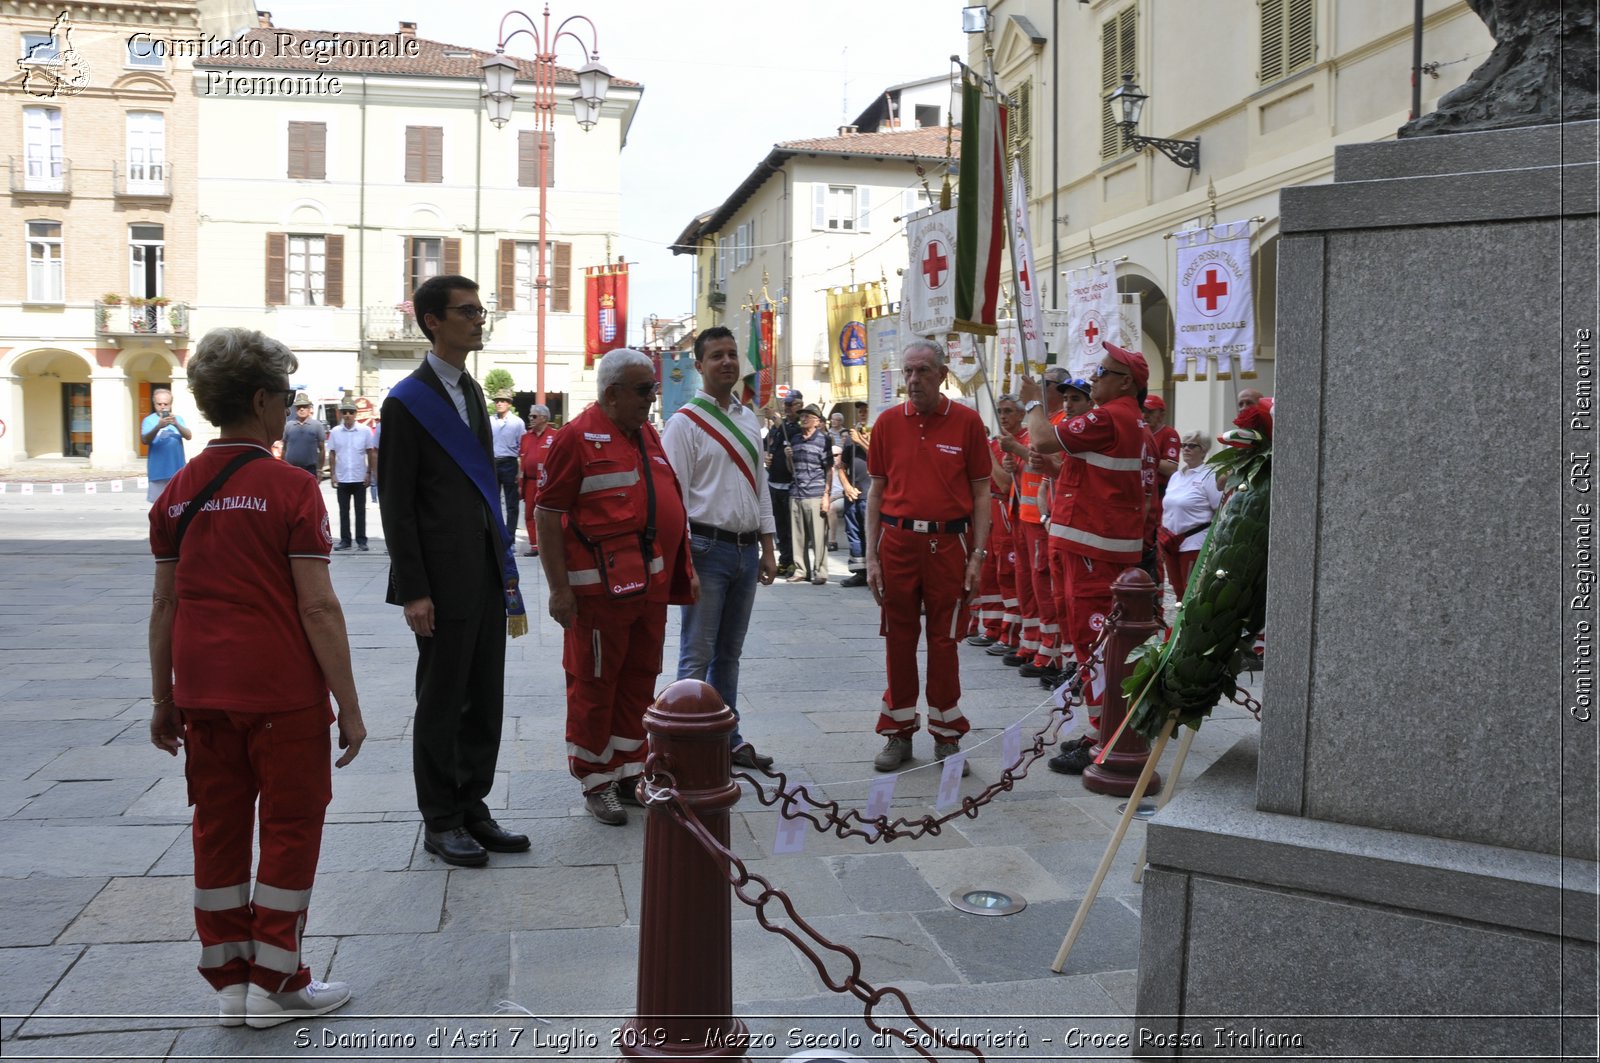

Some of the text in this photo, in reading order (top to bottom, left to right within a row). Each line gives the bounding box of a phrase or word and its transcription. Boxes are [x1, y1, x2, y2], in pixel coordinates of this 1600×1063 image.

[1182, 250, 1243, 287] CROCE ROSSA ITALIANA
[1181, 320, 1247, 332] COMITATO LOCALE
[1208, 334, 1216, 343] DI
[222, 495, 267, 512] ITALIANA
